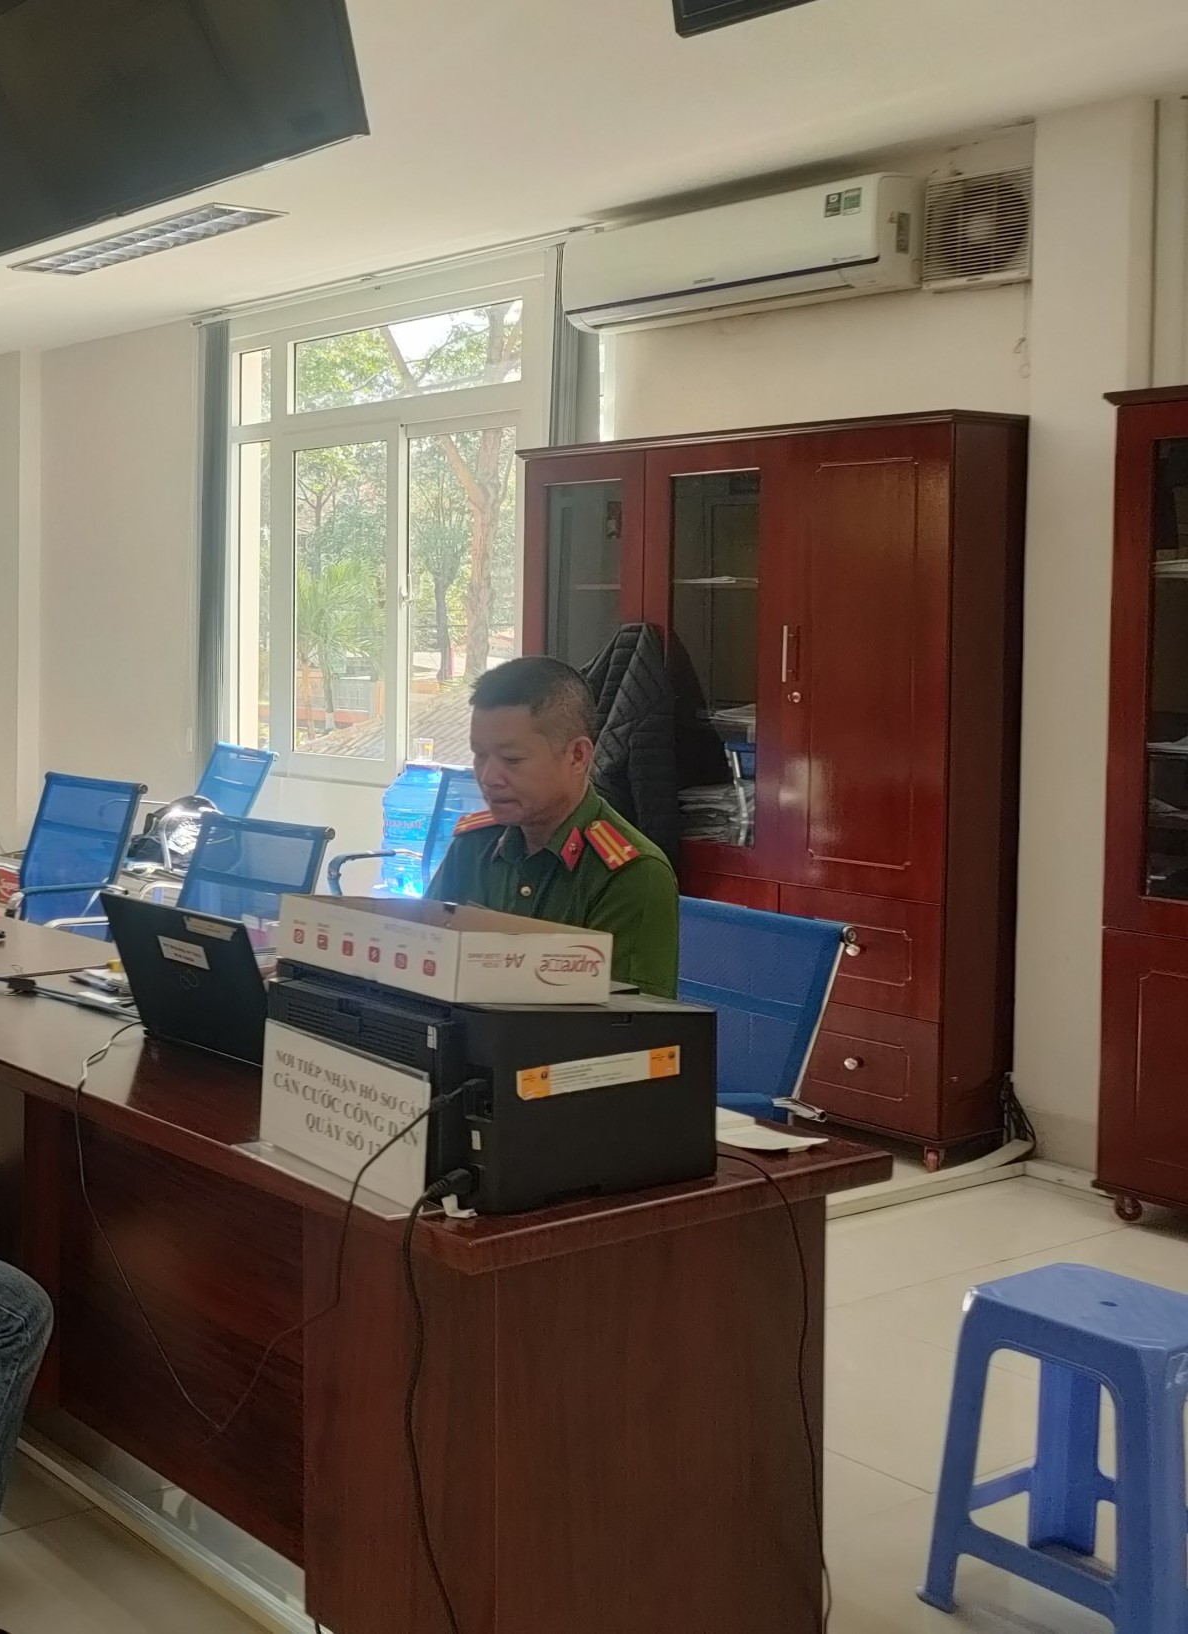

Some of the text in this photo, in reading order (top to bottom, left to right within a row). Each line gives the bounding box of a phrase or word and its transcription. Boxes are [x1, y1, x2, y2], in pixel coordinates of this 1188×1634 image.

[275, 1049, 295, 1069] NƠI
[296, 1056, 322, 1079] TIẾP
[323, 1068, 357, 1094] NHẬN
[272, 1071, 300, 1096] CĂN
[301, 1084, 342, 1114] CƯỚC
[343, 1101, 385, 1133] CÔNG
[305, 1112, 344, 1142] QUẦY
[345, 1129, 365, 1152] SỐ
